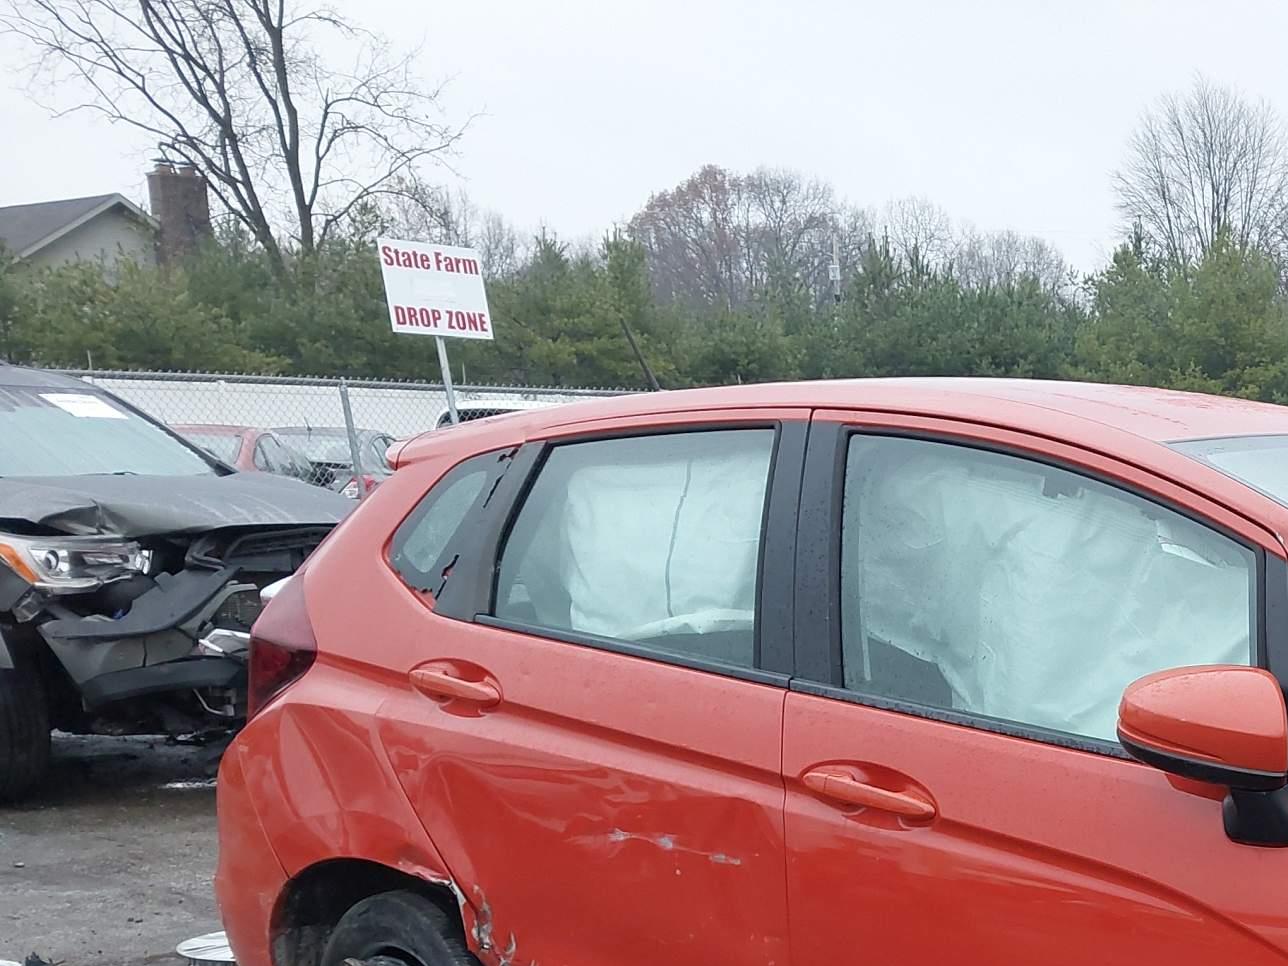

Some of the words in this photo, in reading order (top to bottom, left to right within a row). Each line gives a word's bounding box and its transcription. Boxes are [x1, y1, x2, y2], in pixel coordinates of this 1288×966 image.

[381, 245, 431, 270] State
[434, 252, 479, 275] Farm
[394, 305, 442, 328] DROP
[446, 310, 488, 332] ZONE
